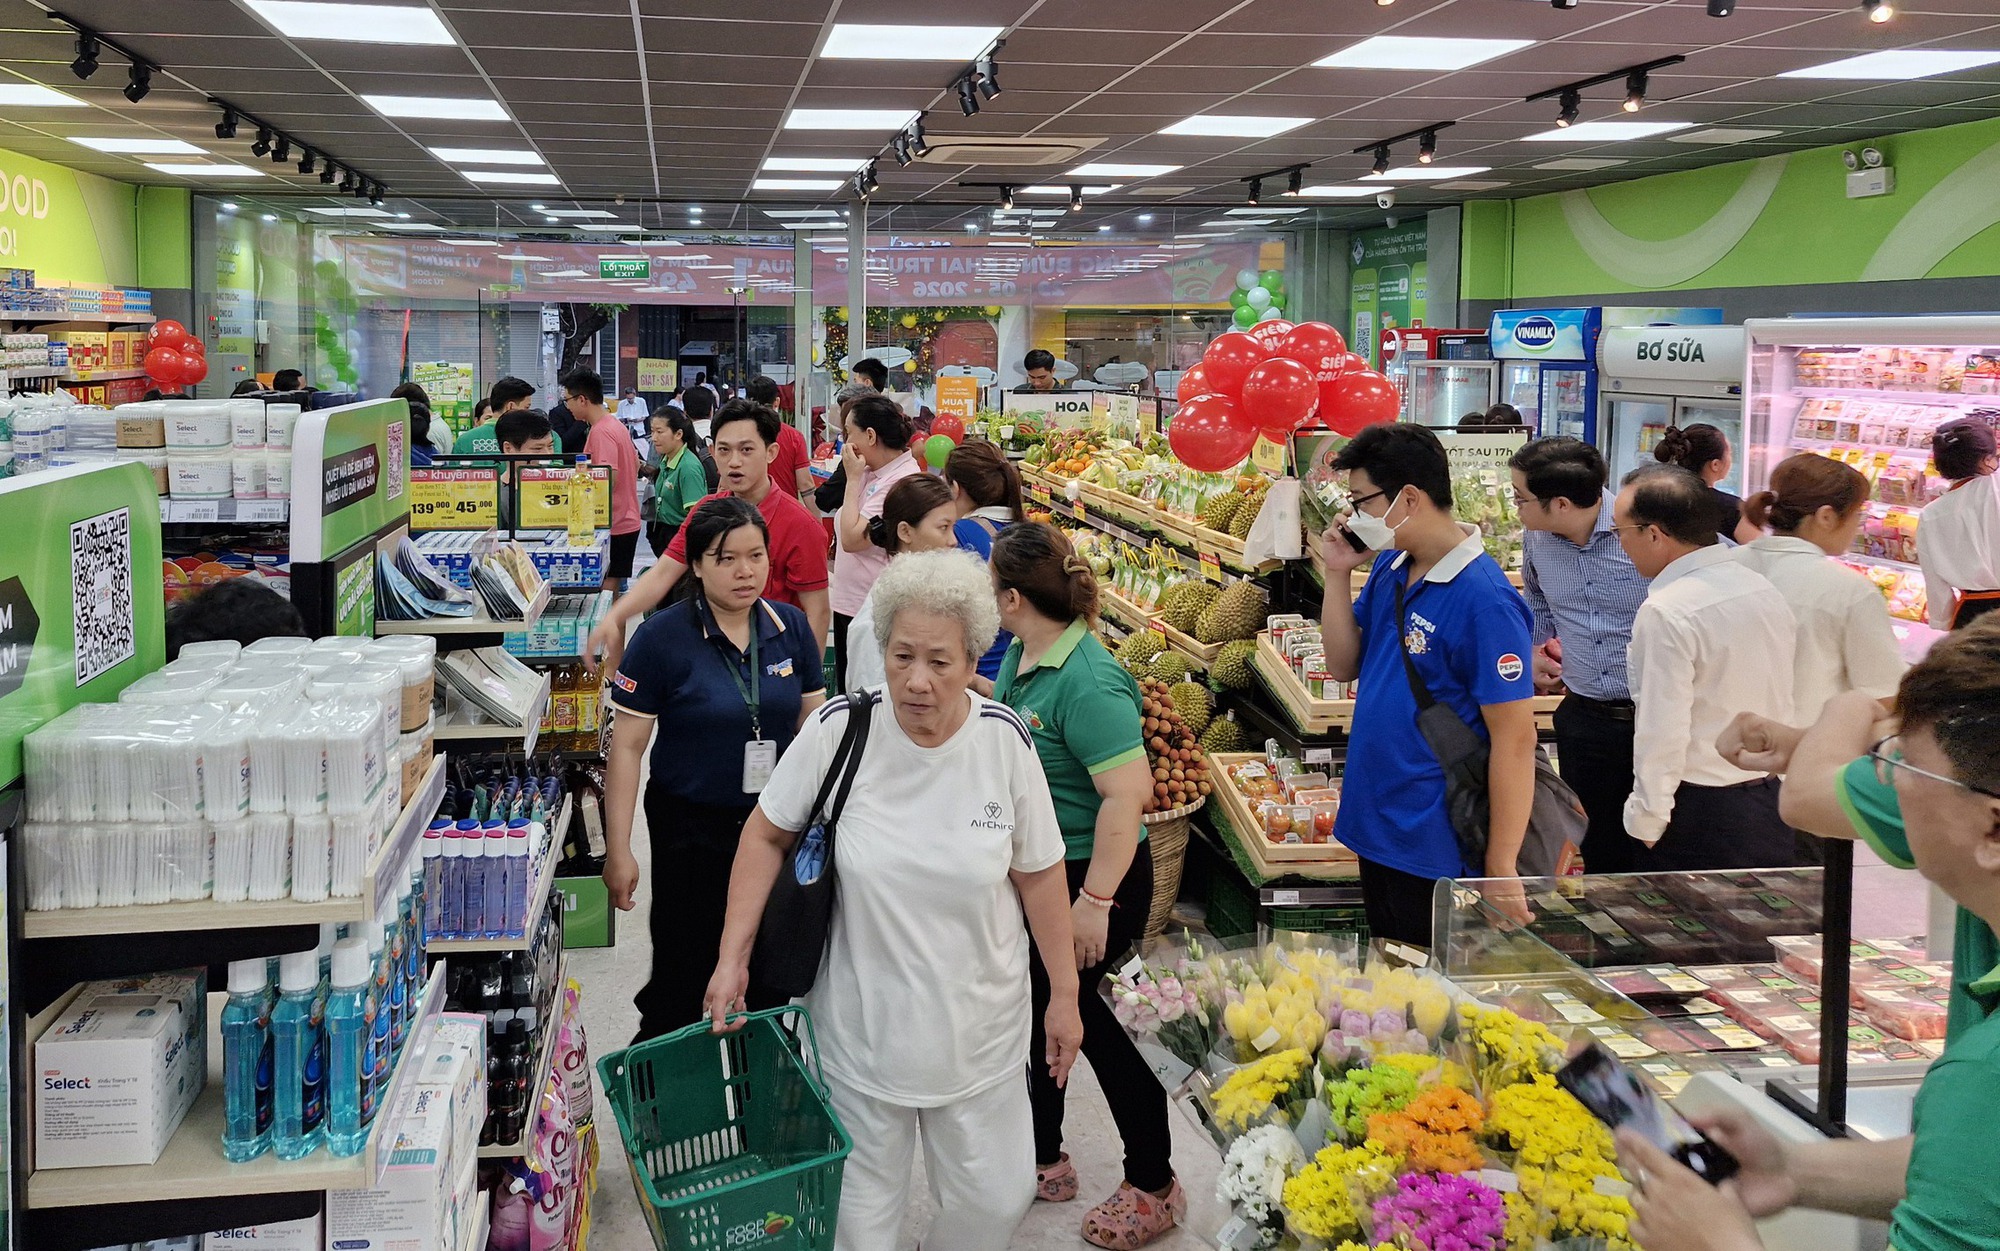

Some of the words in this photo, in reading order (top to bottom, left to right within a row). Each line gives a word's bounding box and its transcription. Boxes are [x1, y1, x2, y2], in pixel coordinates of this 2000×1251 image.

[1517, 326, 1555, 340] VINAMILK
[1636, 338, 1663, 361] BƠ
[1667, 337, 1705, 362] SỮA
[942, 398, 964, 406] MUA
[1055, 401, 1090, 412] HOA
[1468, 447, 1492, 457] SAU
[1494, 447, 1513, 457] 17h
[1410, 611, 1437, 634] PEPSI
[1499, 663, 1521, 671] PEPSI
[44, 1077, 91, 1090] Select
[726, 1219, 765, 1237] COOP
[726, 1228, 766, 1248] FOOD
